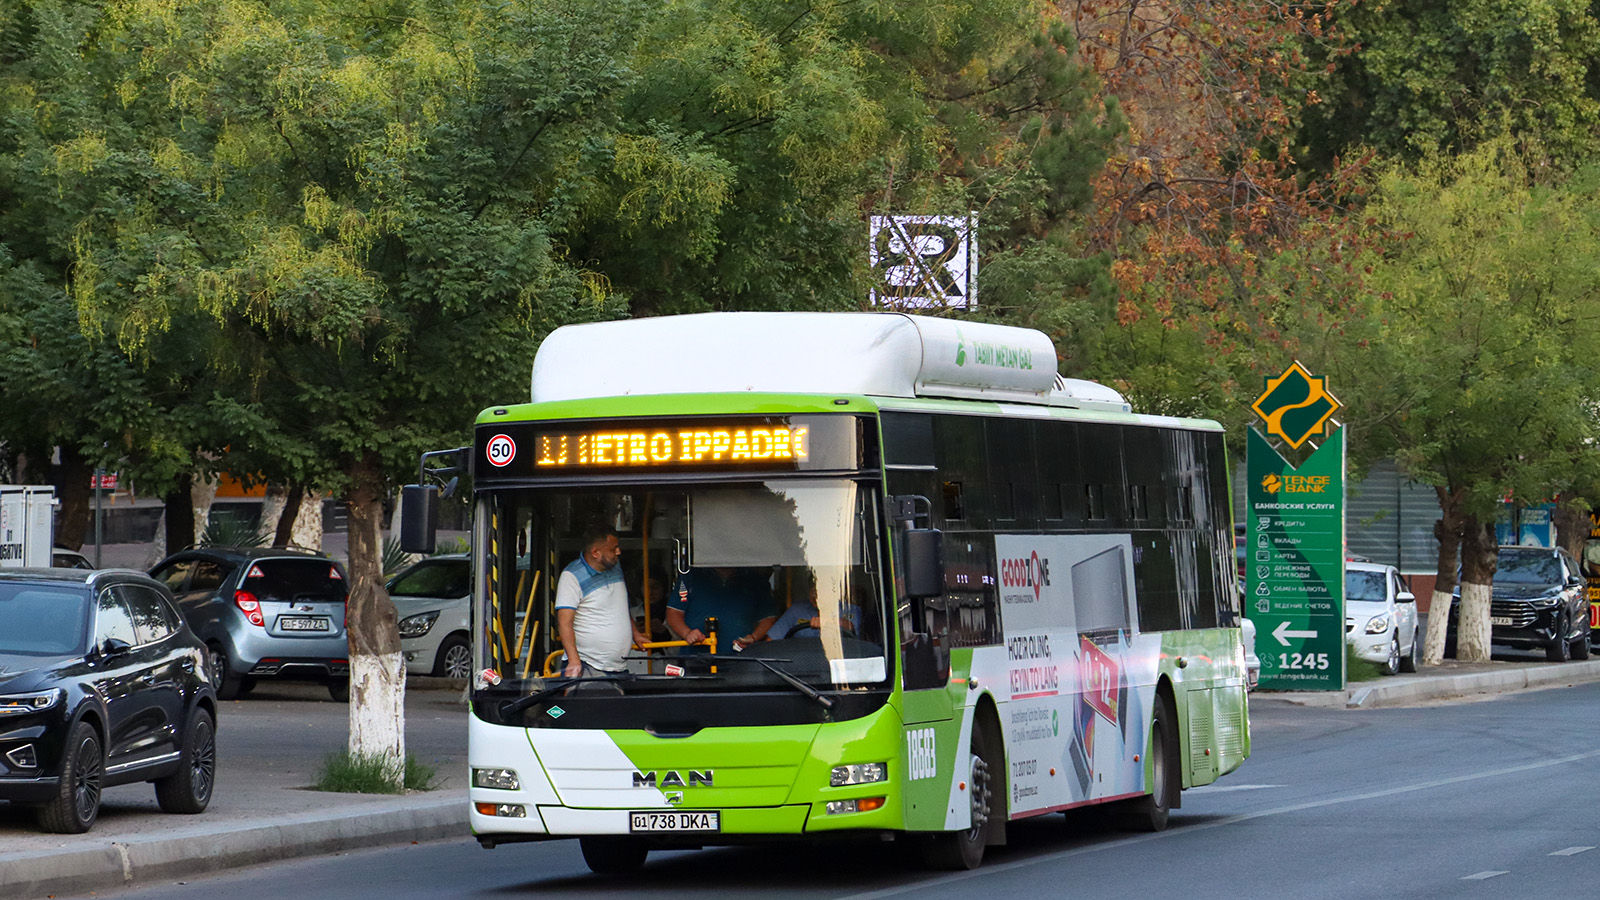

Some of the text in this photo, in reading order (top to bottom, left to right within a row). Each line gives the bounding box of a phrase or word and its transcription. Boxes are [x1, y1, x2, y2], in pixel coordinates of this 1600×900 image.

[491, 443, 511, 458] 50
[579, 431, 671, 464] METRO
[1282, 475, 1331, 485] TENGE
[1285, 484, 1326, 493] BANK
[1254, 502, 1304, 510] БАНКОВСКИЕ
[1001, 552, 1050, 597] GOODZONE
[1278, 652, 1330, 670] 1245
[1009, 668, 1028, 693] KEYIN
[906, 727, 937, 782] 18683
[632, 769, 715, 788] MAN
[634, 814, 710, 829] 01 738 DKA
